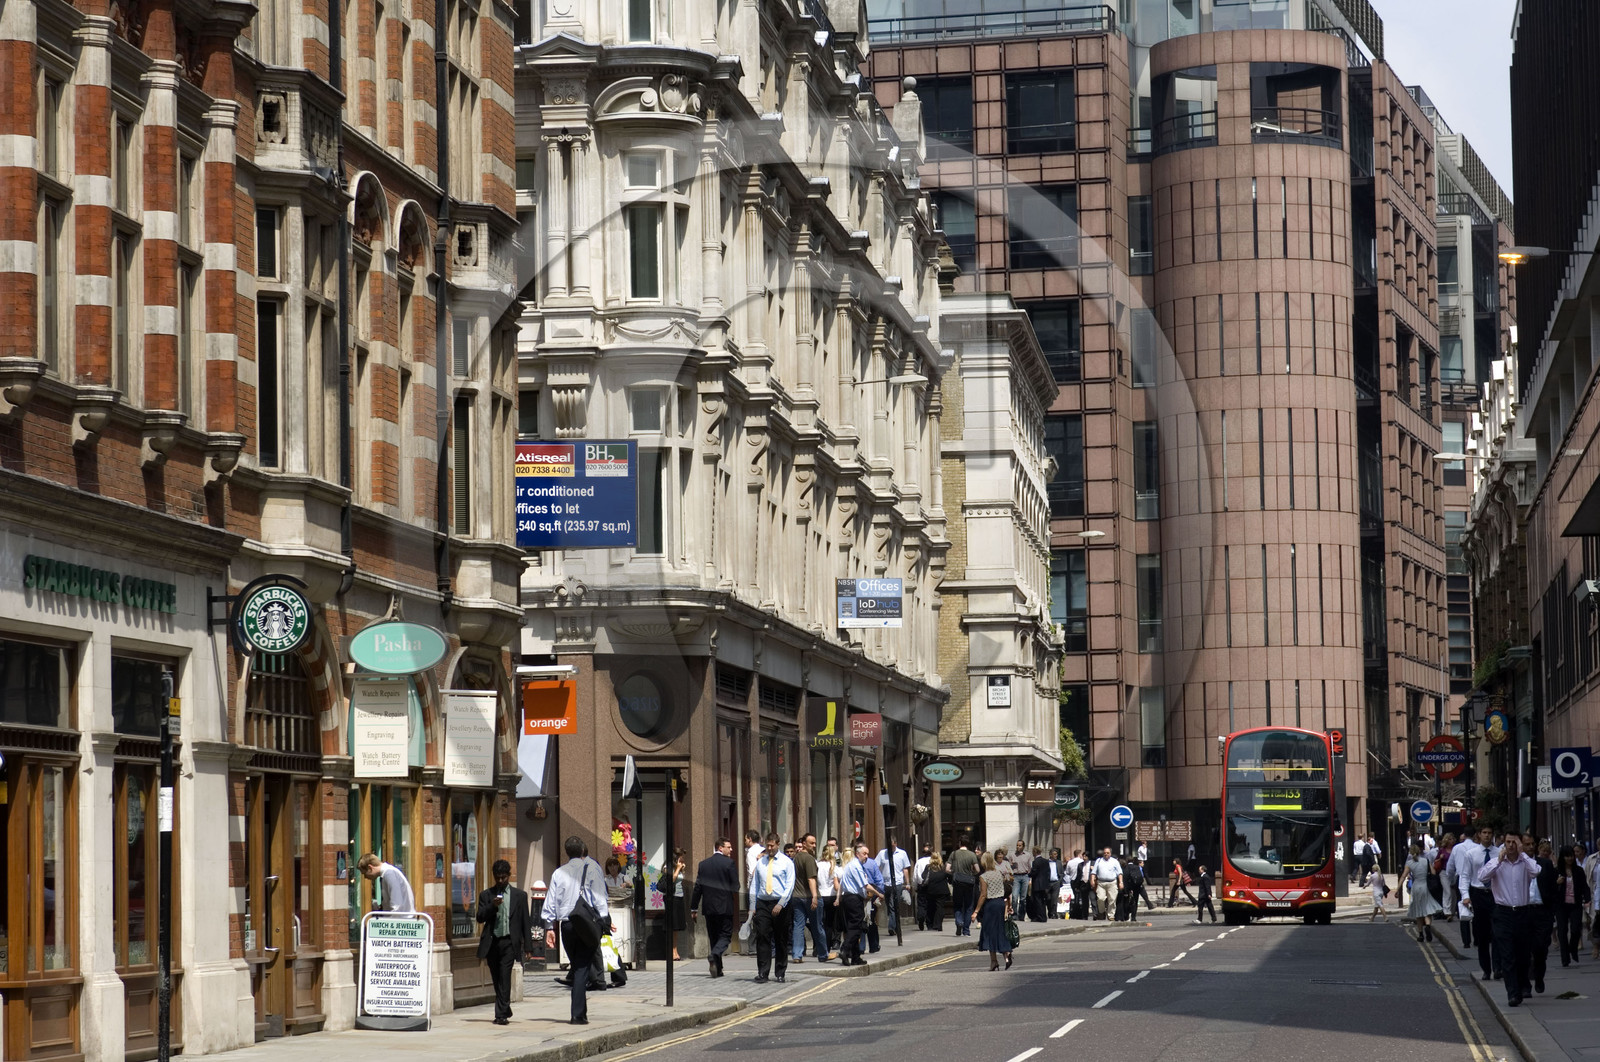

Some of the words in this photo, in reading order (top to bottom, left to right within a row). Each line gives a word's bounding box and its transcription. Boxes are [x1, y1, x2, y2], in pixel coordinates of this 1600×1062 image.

[516, 466, 530, 474] 020
[532, 466, 550, 474] 7338
[552, 466, 570, 474] 4400
[516, 486, 525, 496] ir
[527, 486, 594, 497] conditioned
[515, 503, 548, 514] ffices
[551, 504, 562, 514] to
[566, 503, 580, 514] let
[515, 521, 536, 533] ,540
[539, 520, 561, 533] sq.ft
[564, 520, 599, 534] (235.97
[602, 520, 630, 534] sq.m)
[24, 554, 121, 605] STARBUCKS
[122, 575, 177, 615] COFFEE
[859, 580, 899, 591] Offices
[247, 589, 305, 619] STARBUCKS
[859, 599, 876, 608] IoD
[877, 599, 899, 608] hub
[252, 631, 298, 649] COFFEE
[373, 633, 422, 653] Pasha
[379, 690, 401, 698] Repairs
[470, 705, 488, 713] Repairs
[357, 711, 382, 719] Jewellery
[383, 711, 405, 719] Repairs
[529, 718, 568, 729] orange
[852, 720, 878, 728] Phase
[448, 724, 472, 733] Jewellery
[473, 724, 493, 732] Repairs
[367, 731, 395, 739] Engraving
[852, 730, 874, 740] Eight
[456, 743, 482, 751] Engraving
[810, 737, 844, 748] JONES
[381, 752, 401, 760] Battery
[363, 759, 381, 767] Fitting
[469, 762, 487, 770] Battery
[452, 768, 468, 776] Fitting
[469, 768, 486, 776] Centre
[1555, 752, 1590, 784] O2
[1027, 780, 1052, 790] EAT.
[396, 923, 425, 931] JEWELLERY
[371, 940, 392, 948] WATCH
[393, 940, 423, 949] BATTERIES
[375, 962, 411, 970] WATERPROOF
[371, 970, 397, 978] PRESSURE
[399, 971, 421, 979] TESTING
[370, 978, 392, 986] SERVICE
[393, 979, 421, 987] AVAILABLE
[381, 989, 410, 997] ENGRAVING
